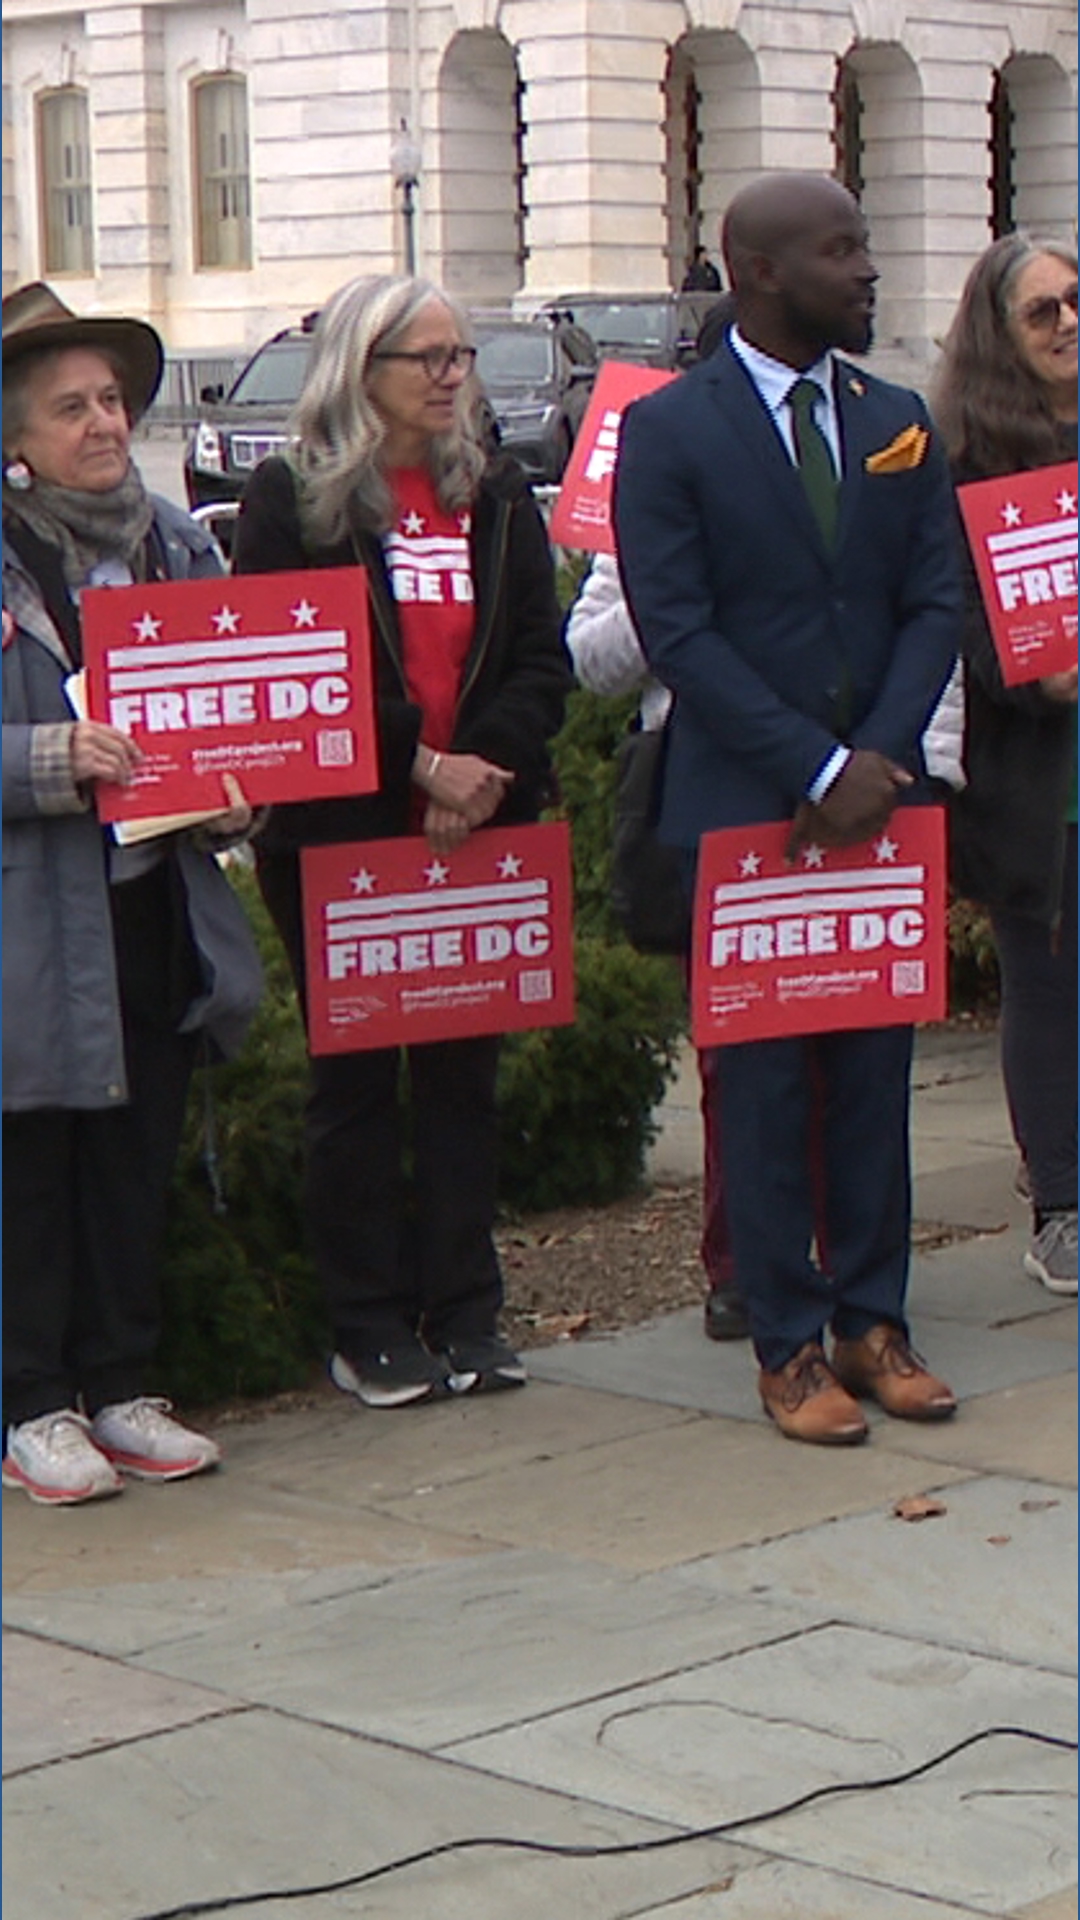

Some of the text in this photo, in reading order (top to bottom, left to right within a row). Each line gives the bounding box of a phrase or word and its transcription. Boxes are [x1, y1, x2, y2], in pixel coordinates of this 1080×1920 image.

[392, 569, 443, 604] EE
[997, 559, 1078, 611] FRE
[109, 676, 349, 735] FREE DC
[327, 920, 549, 980] FREE DC
[711, 909, 924, 968] FREE DC
